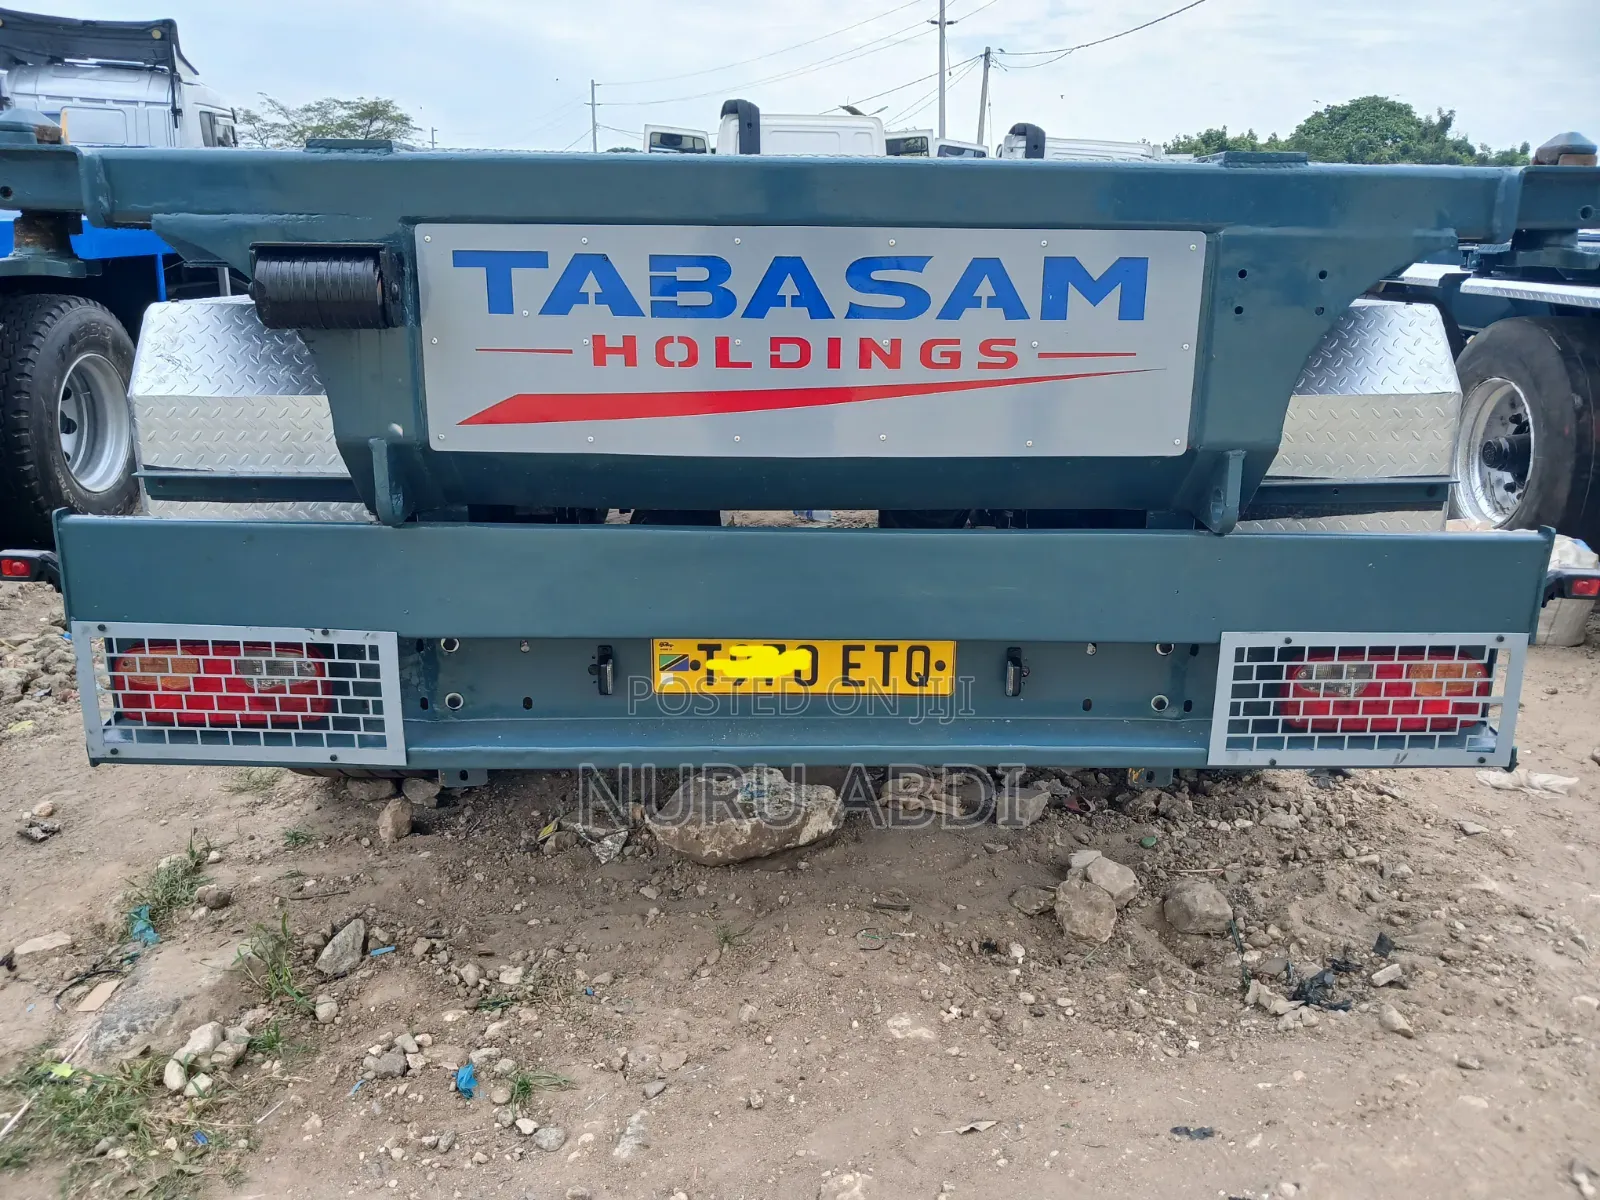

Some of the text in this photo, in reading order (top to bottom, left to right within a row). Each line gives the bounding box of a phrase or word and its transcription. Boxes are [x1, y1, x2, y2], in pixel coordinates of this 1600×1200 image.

[452, 249, 1149, 321] TABASAM
[592, 334, 1018, 370] HOLDINGS
[842, 644, 932, 688] ETQ
